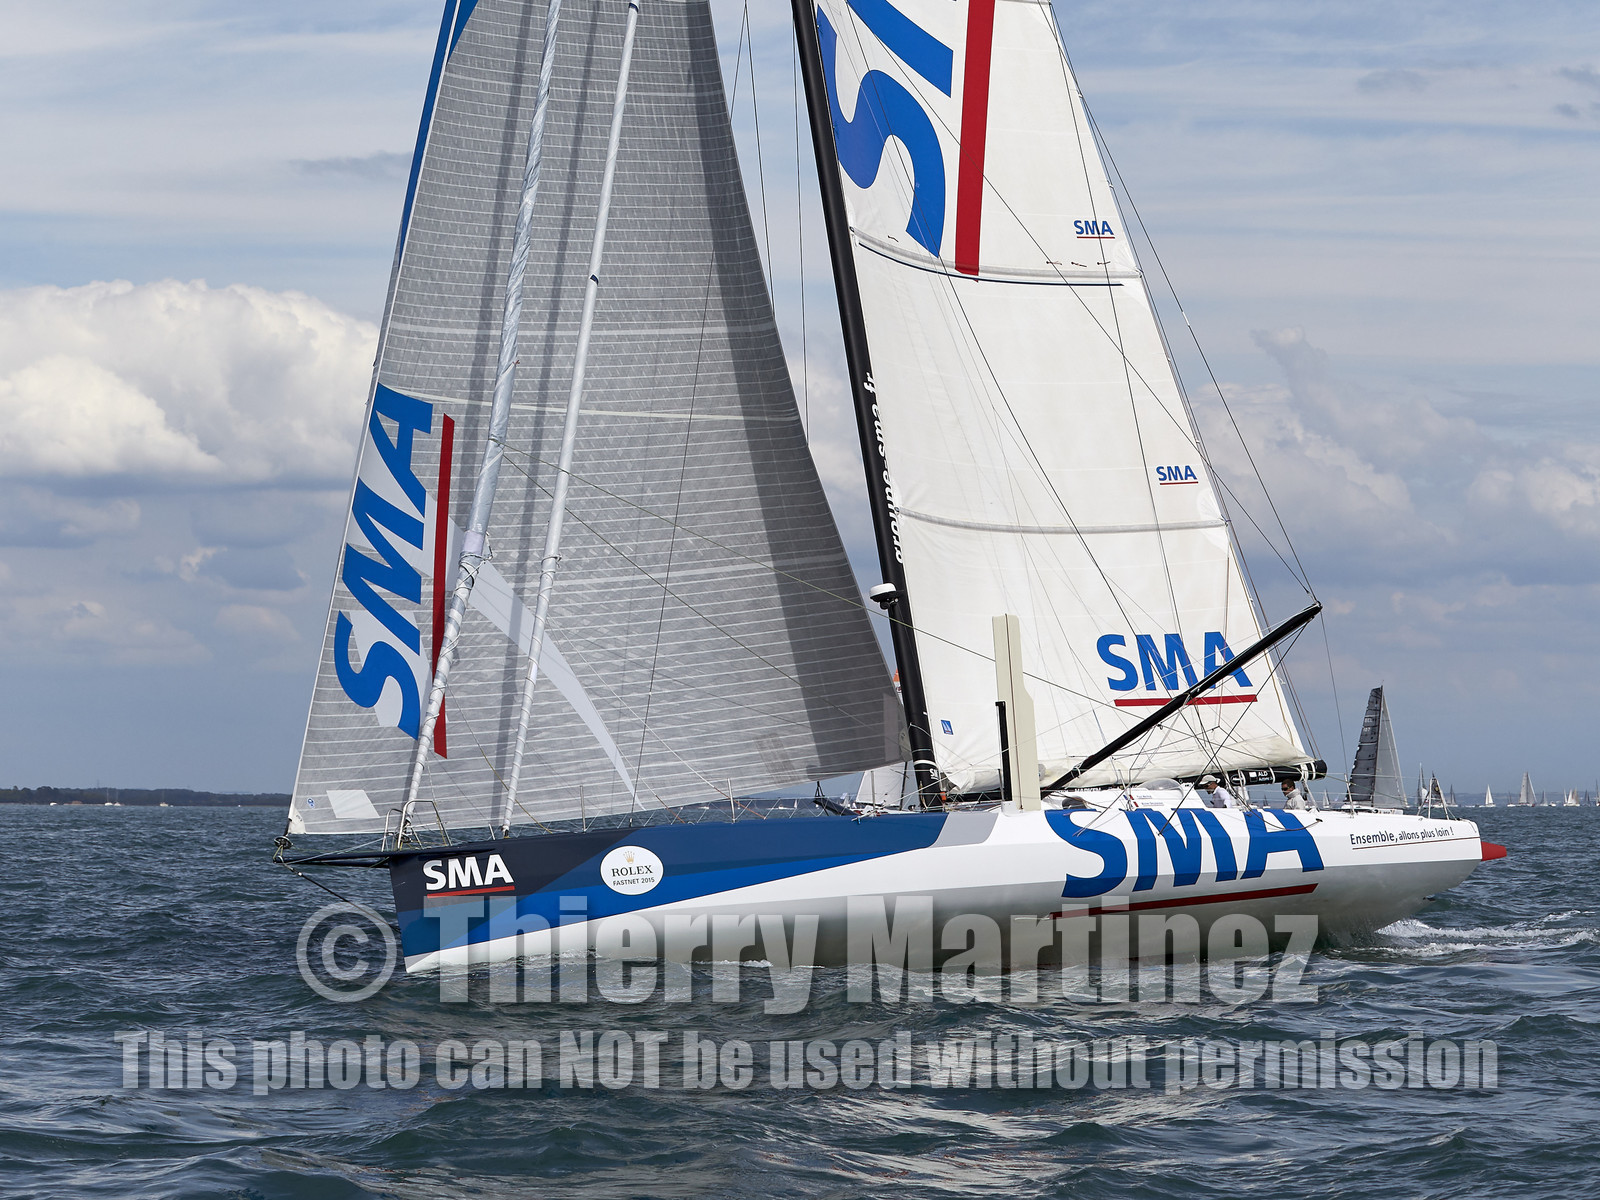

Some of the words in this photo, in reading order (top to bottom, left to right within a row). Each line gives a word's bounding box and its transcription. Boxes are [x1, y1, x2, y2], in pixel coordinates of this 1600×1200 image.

[1073, 220, 1114, 235] SMA
[1156, 465, 1198, 481] SMA
[334, 382, 433, 740] SMA
[1096, 631, 1254, 692] SMA
[1350, 831, 1398, 845] Ensemble,
[1398, 830, 1419, 840] allons
[1420, 828, 1435, 840] plus
[1435, 827, 1449, 837] loin
[1044, 808, 1325, 899] SMA
[423, 854, 514, 891] SMA
[611, 865, 653, 877] ROLEX
[613, 878, 639, 886] FASTNET
